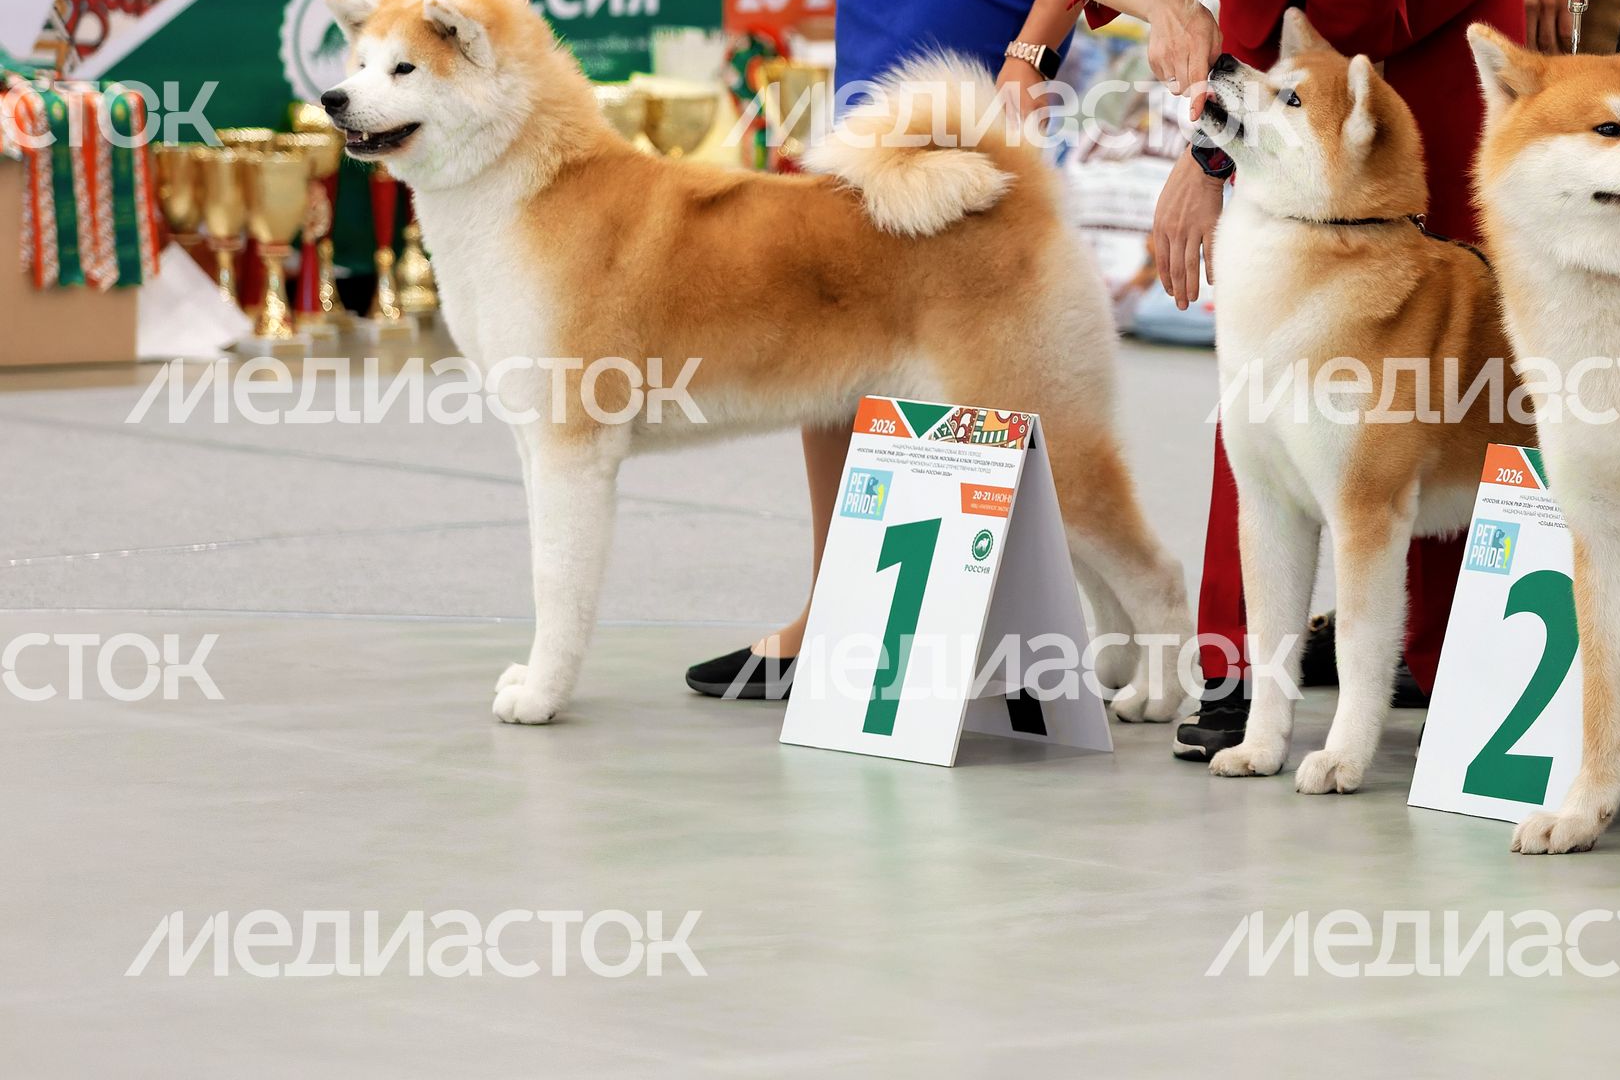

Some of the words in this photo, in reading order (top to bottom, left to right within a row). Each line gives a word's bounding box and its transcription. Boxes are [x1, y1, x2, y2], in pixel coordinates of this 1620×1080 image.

[869, 418, 896, 434] 2026
[850, 472, 871, 493] PET
[1496, 468, 1523, 484] 2026
[972, 490, 991, 501] 20-21
[1474, 523, 1497, 545] PET
[964, 564, 991, 574] РОССИЯ
[862, 517, 942, 736] 1
[1462, 570, 1580, 805] 2
